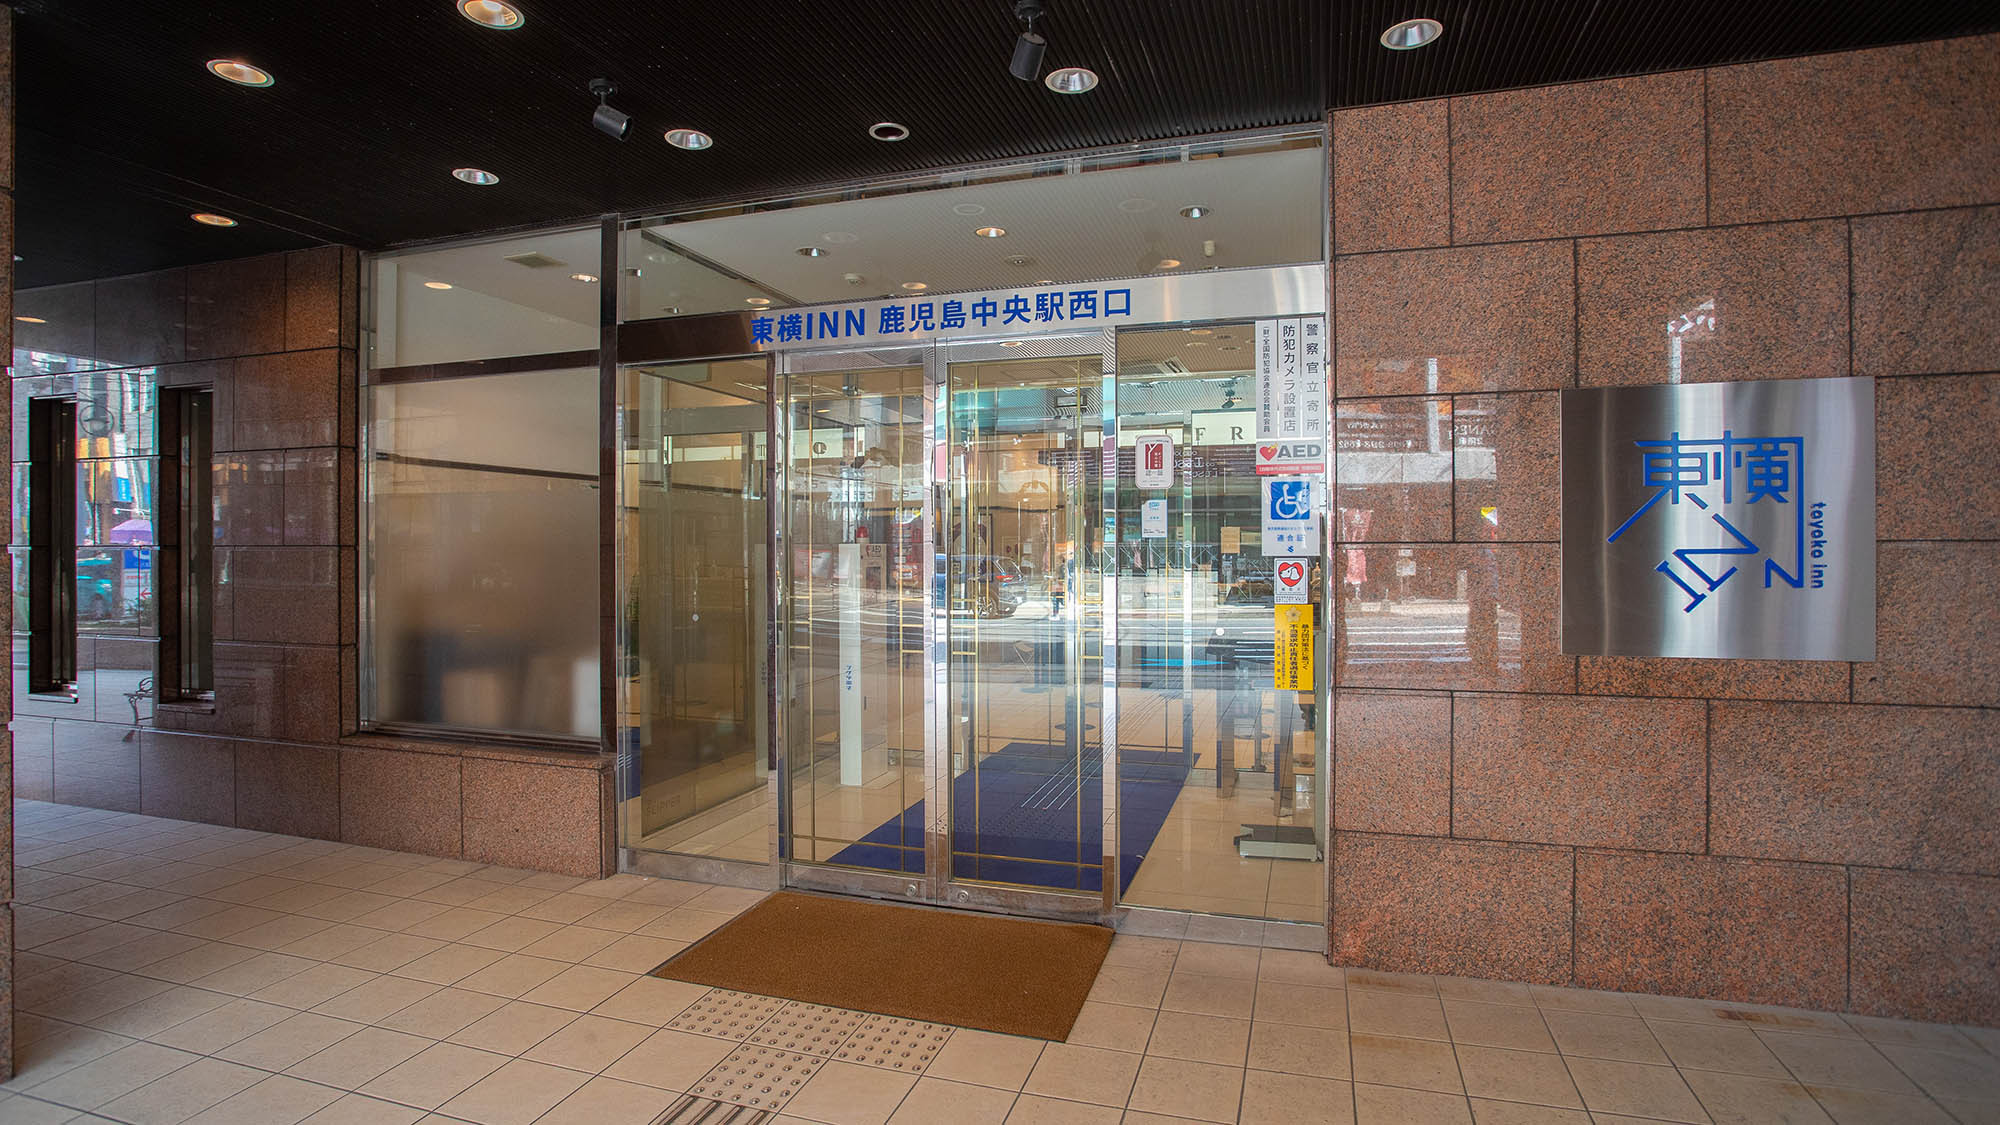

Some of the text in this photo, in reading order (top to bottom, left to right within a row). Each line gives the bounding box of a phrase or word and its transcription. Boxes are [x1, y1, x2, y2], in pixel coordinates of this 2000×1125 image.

[750, 287, 1132, 345] 東横INN 鹿児島中央駅西口
[1283, 325, 1297, 432] 防犯カメラ設置店
[1306, 323, 1319, 432] 警察官立寄所
[1277, 444, 1322, 458] AED
[1808, 502, 1828, 589] toyoko inn
